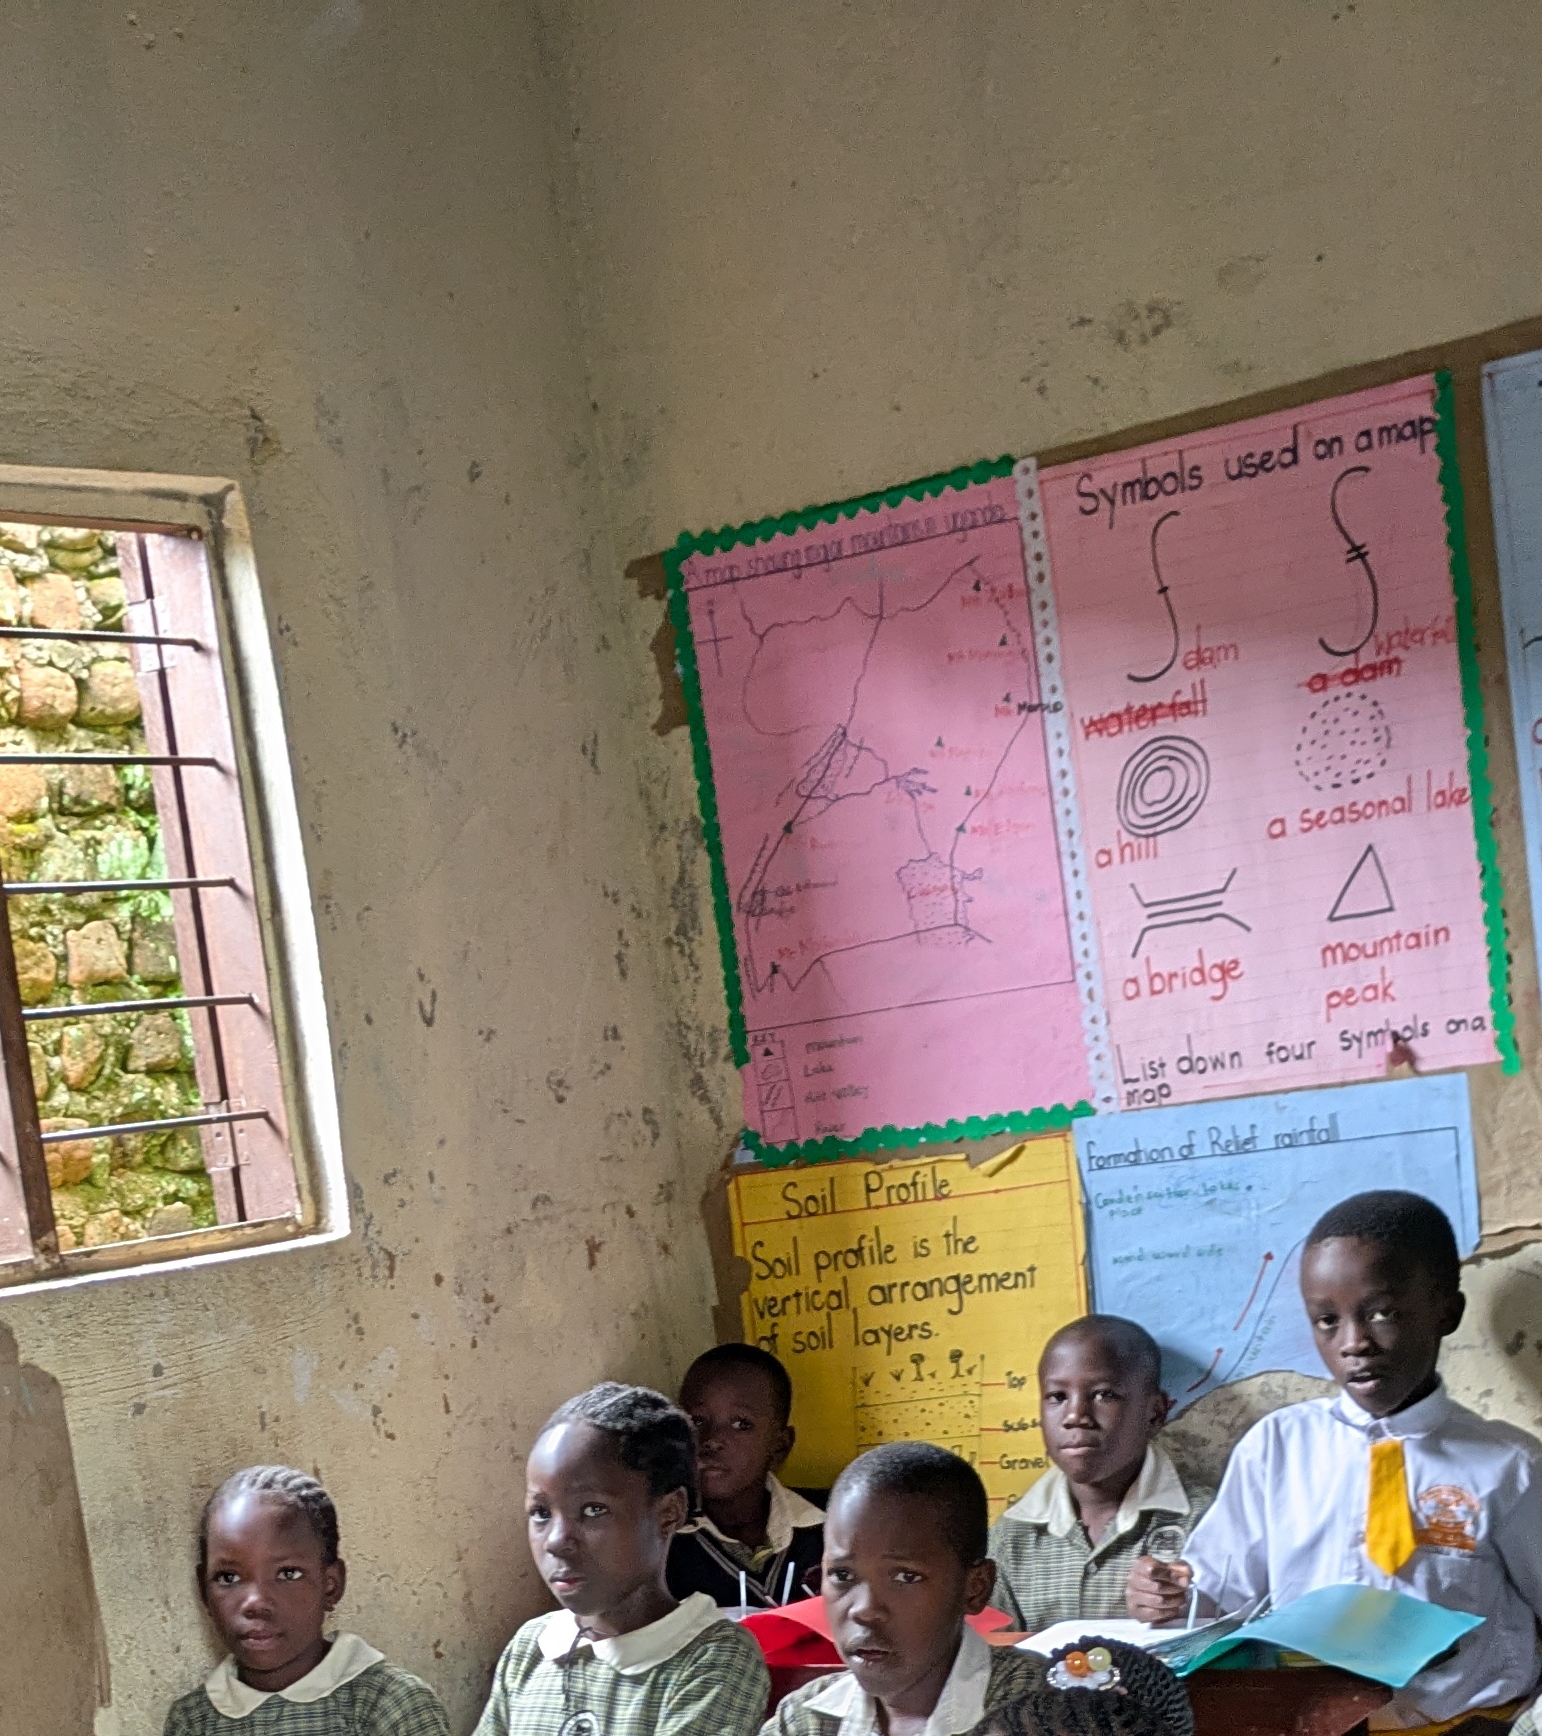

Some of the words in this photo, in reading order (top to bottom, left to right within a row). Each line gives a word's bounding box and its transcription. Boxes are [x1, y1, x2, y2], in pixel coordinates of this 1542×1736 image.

[1077, 448, 1205, 530] Symbols
[1224, 421, 1300, 481] used
[1312, 431, 1344, 461] on
[1355, 429, 1374, 453] a
[1377, 415, 1437, 455] map
[1182, 623, 1241, 673] dam
[1265, 815, 1288, 841] a
[1299, 775, 1414, 835] seasonal
[1425, 768, 1470, 815] lake
[1094, 845, 1114, 868] a
[1115, 829, 1159, 865] hill
[1321, 923, 1452, 969] mountain
[1121, 976, 1141, 1002] a
[1144, 947, 1246, 1001] bridge
[1323, 966, 1397, 1023] peak
[1115, 1042, 1168, 1085] List
[1176, 1033, 1243, 1076] down
[1265, 1038, 1317, 1066] four
[1125, 1083, 1172, 1107] map
[1178, 1129, 1197, 1160] of
[1206, 1122, 1260, 1156] Relief
[1273, 1111, 1341, 1149] rainfall
[781, 1176, 838, 1221] Soil
[863, 1164, 953, 1211] Profile
[750, 1235, 802, 1281] Soil
[813, 1224, 898, 1283] profile
[912, 1235, 932, 1258] is
[943, 1214, 981, 1257] the
[867, 1263, 1039, 1316] arrangement
[757, 1321, 780, 1356] of
[791, 1311, 835, 1355] soil
